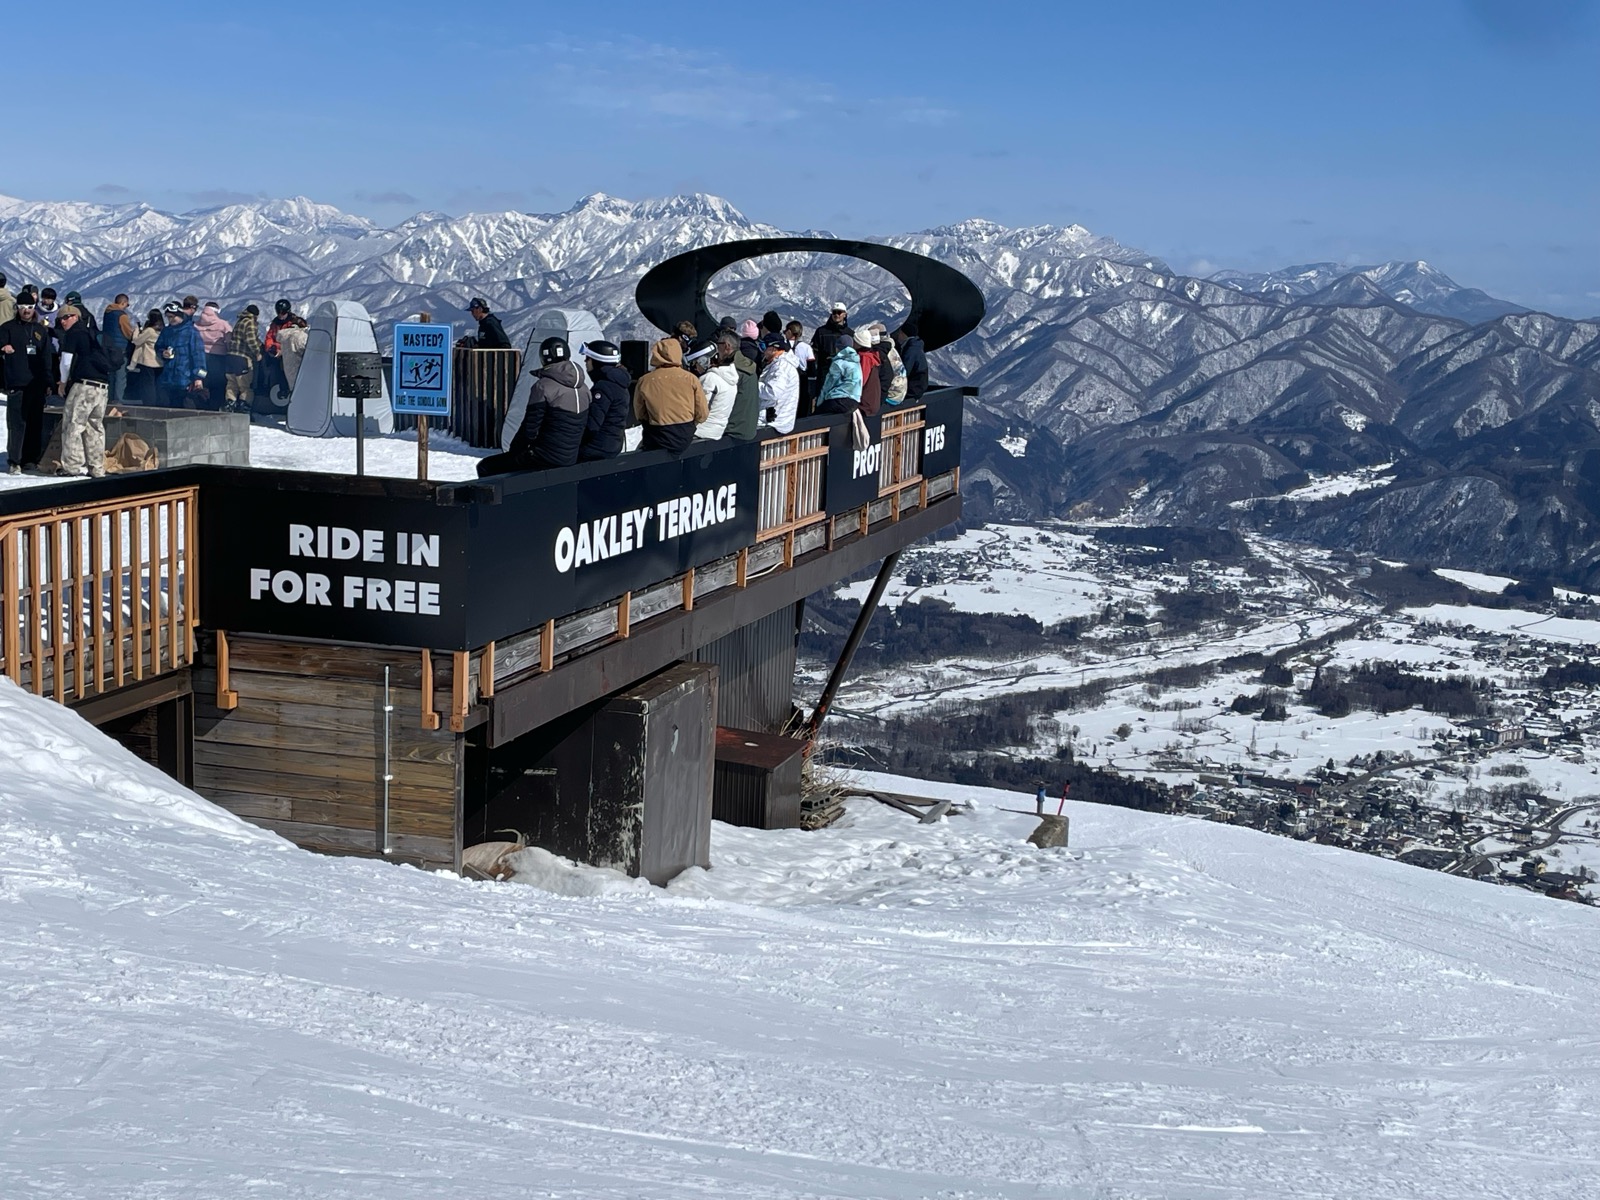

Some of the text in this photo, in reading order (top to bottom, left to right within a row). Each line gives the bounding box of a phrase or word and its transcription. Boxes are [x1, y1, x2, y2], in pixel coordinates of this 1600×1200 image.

[403, 333, 444, 348] WASTED?
[924, 423, 946, 455] EYES
[657, 482, 737, 542] TERRACE
[289, 523, 440, 568] RIDE IN
[250, 567, 441, 616] FOR FREE
